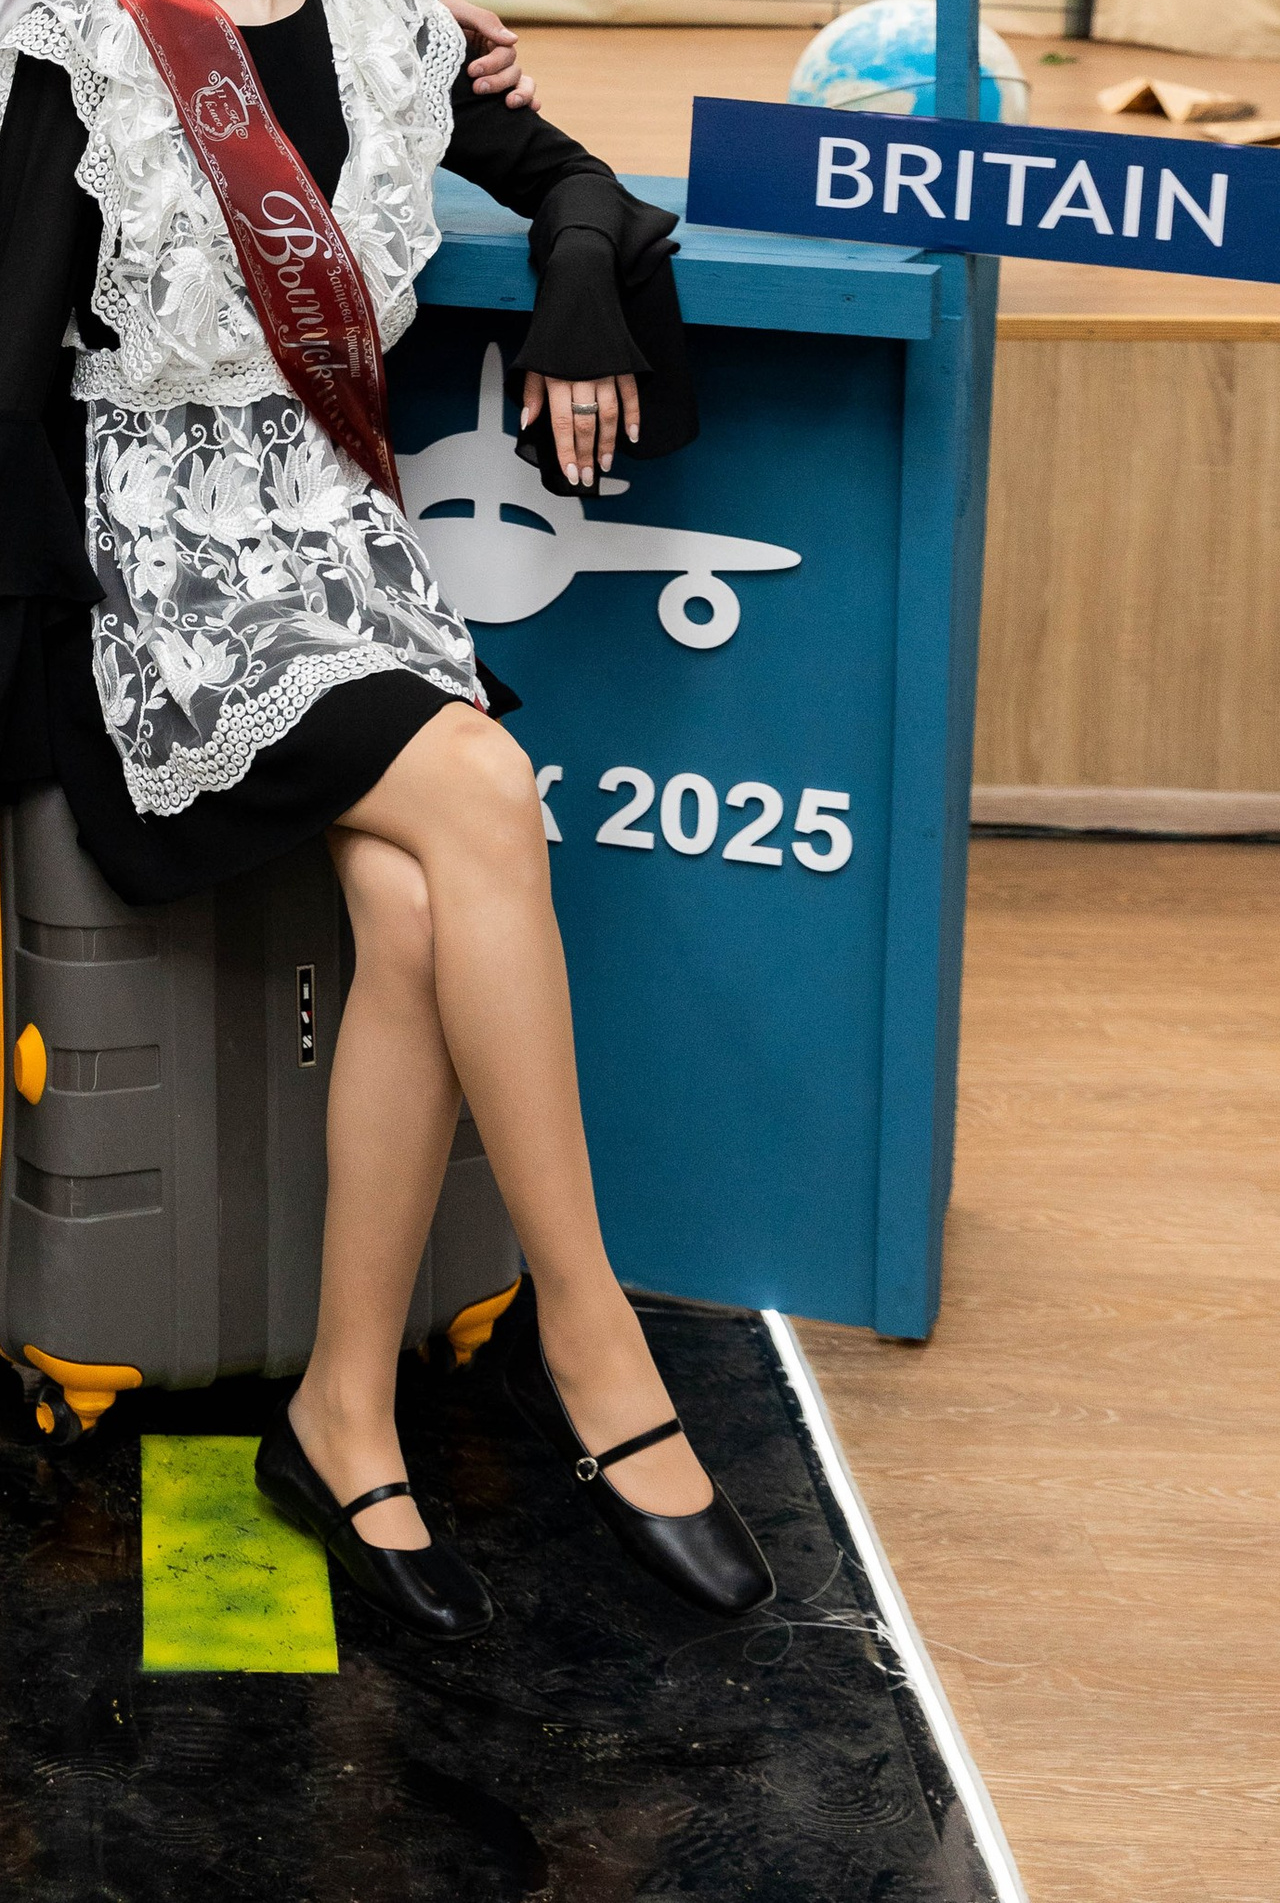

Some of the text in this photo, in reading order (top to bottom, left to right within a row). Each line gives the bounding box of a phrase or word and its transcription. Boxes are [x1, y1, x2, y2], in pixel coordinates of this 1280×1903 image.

[204, 100, 223, 127] класс
[215, 88, 227, 99] 11
[814, 136, 1229, 247] BRITAIN
[326, 265, 361, 379] Зайцева Кристина
[596, 766, 853, 872] 2025
